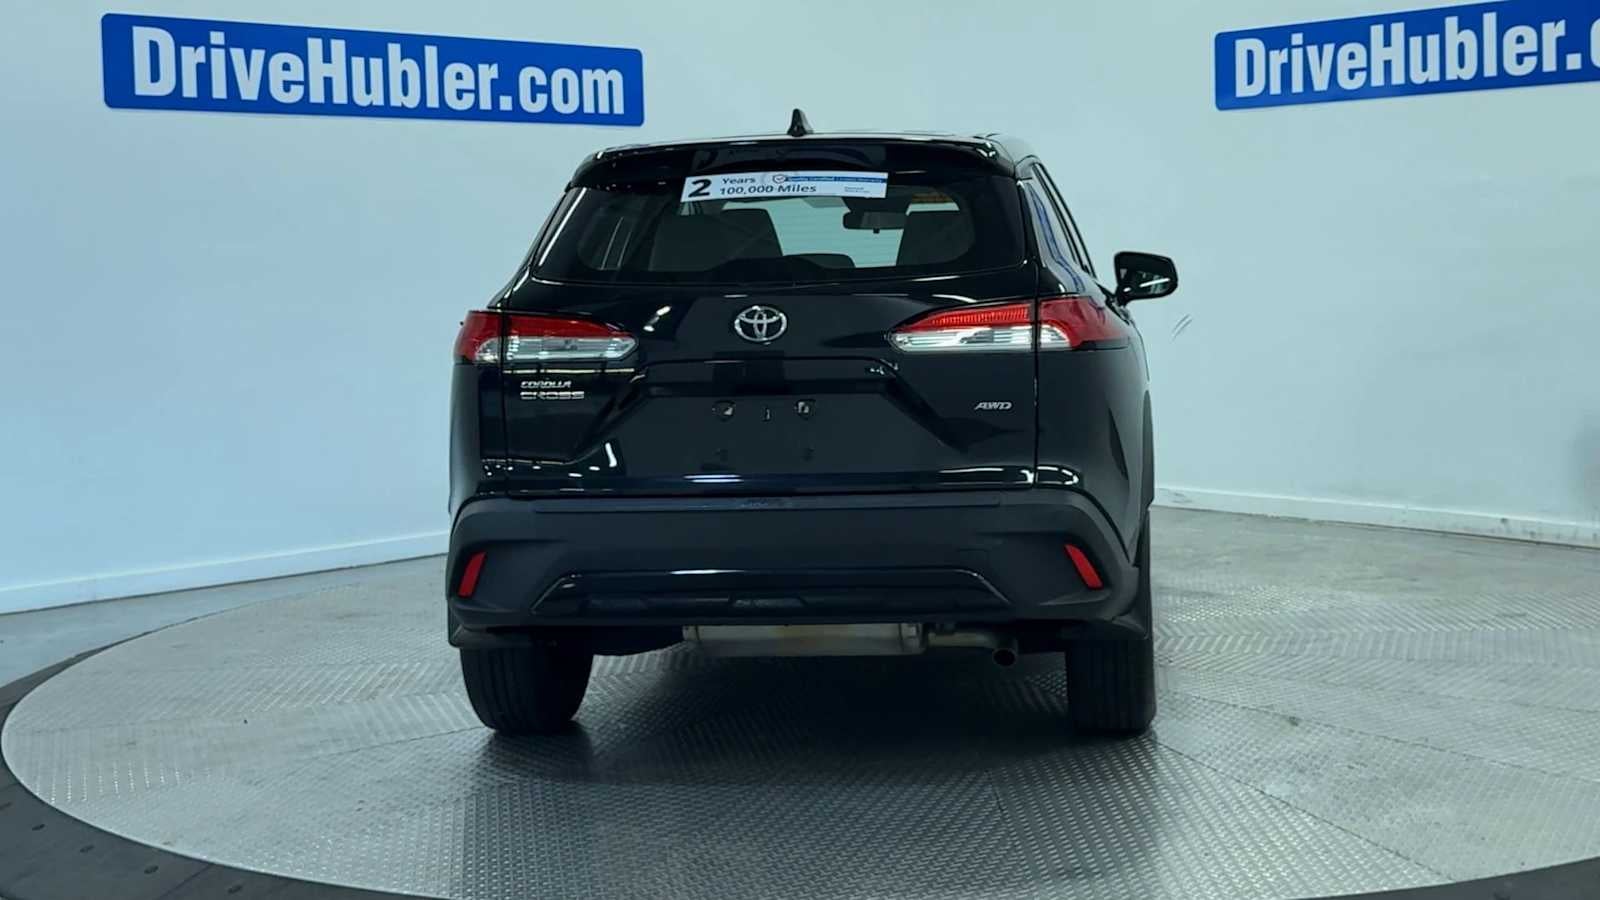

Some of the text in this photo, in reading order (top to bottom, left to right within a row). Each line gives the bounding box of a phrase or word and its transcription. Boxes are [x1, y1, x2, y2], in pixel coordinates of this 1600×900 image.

[132, 25, 625, 115] DriveHubler.com
[721, 177, 756, 185] Years
[687, 178, 712, 198] 2
[720, 184, 817, 195] 100,000 Miles
[520, 380, 572, 389] COROLLA
[520, 390, 585, 400] CROSS
[974, 401, 1013, 410] AWD
